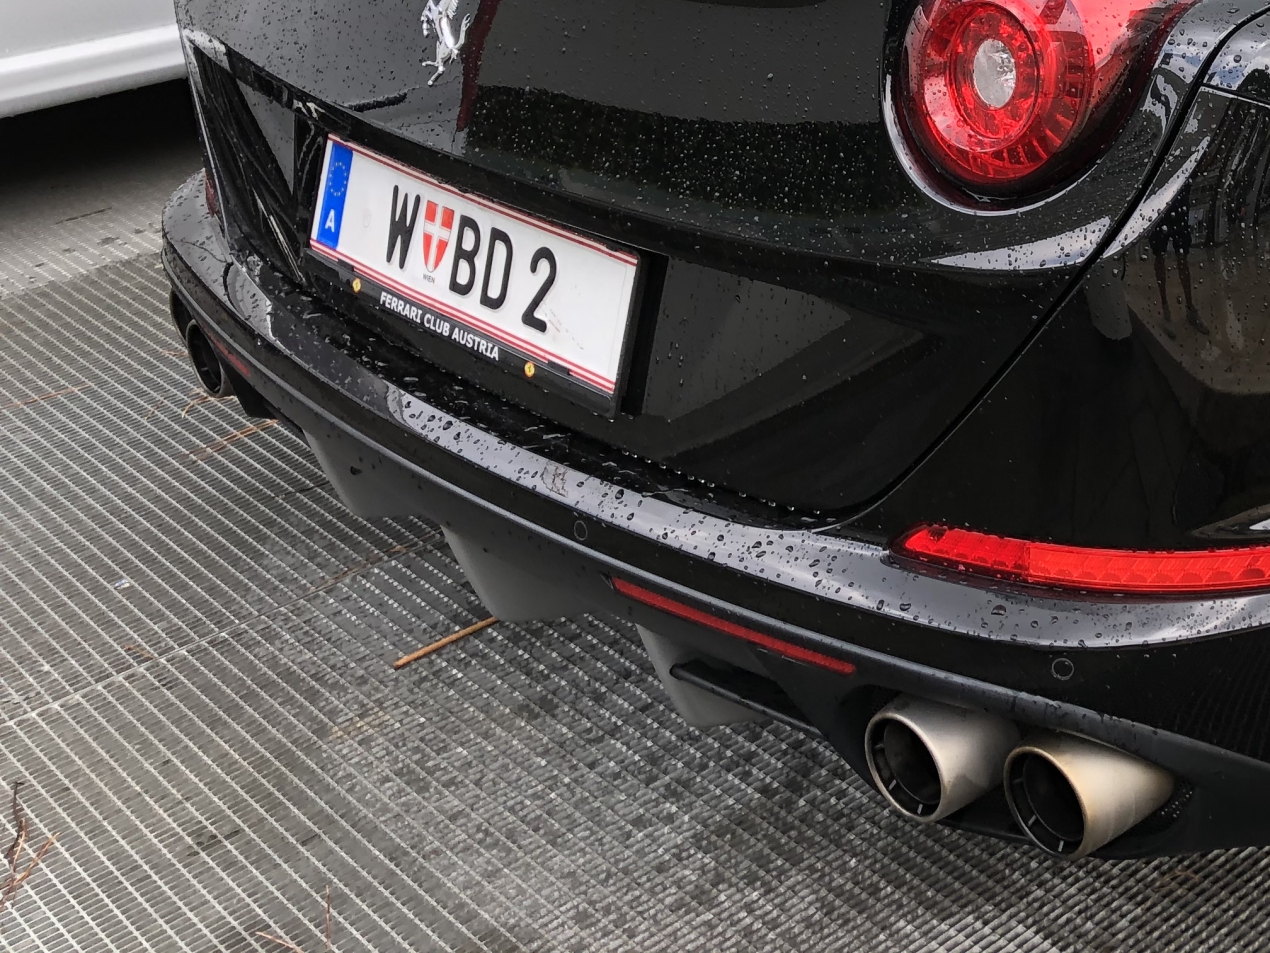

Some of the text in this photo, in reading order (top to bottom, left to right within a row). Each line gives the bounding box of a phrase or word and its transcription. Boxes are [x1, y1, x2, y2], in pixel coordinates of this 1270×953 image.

[325, 209, 336, 233] A
[385, 184, 557, 333] W BD 2
[422, 273, 436, 284] WIEN
[380, 291, 499, 361] FERRARI CLUB AUSTRIA
